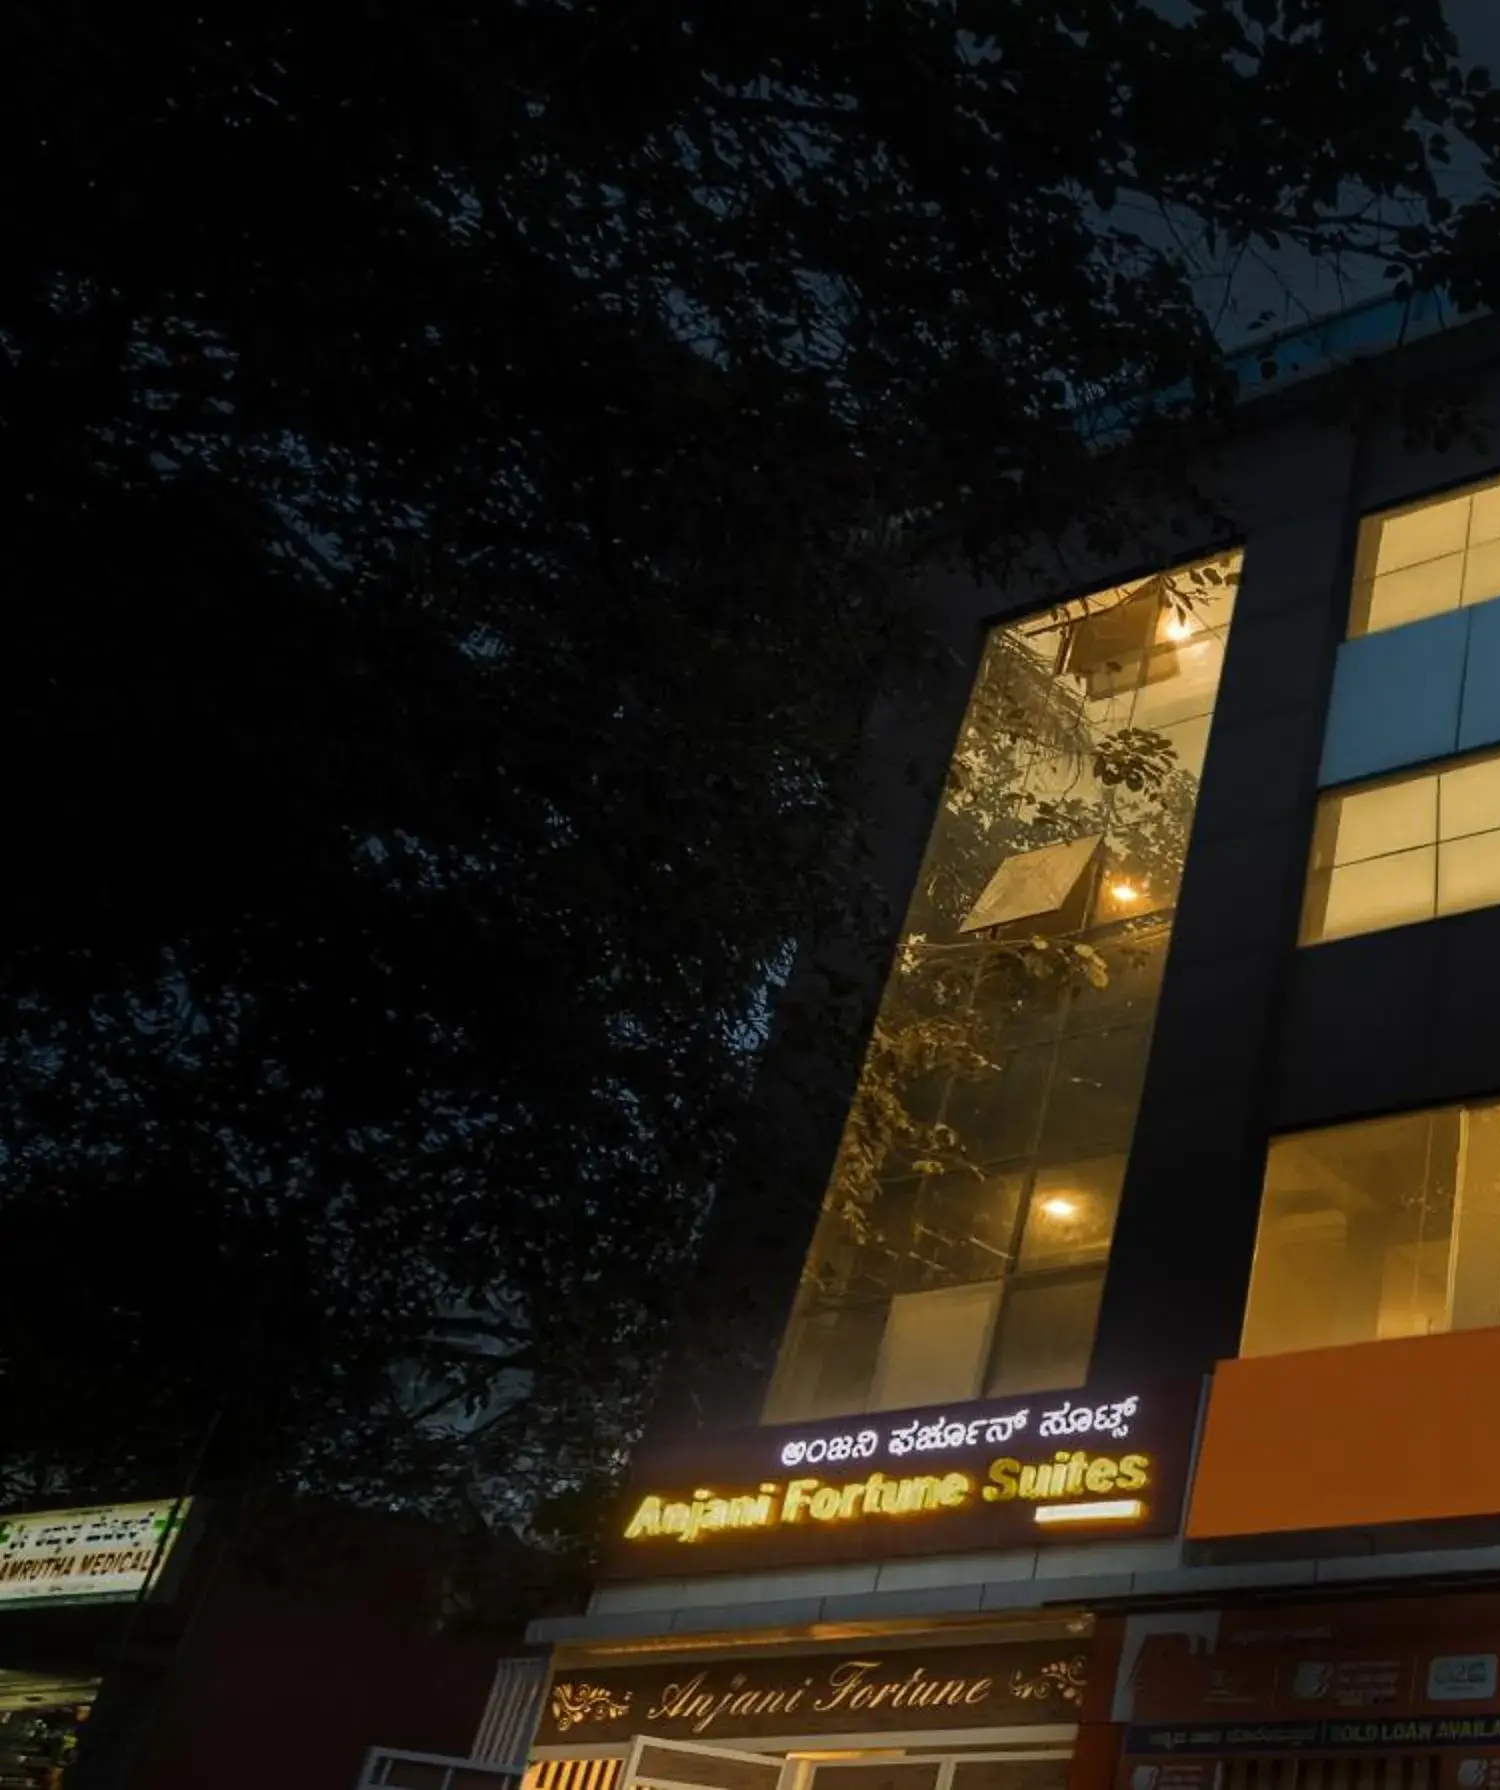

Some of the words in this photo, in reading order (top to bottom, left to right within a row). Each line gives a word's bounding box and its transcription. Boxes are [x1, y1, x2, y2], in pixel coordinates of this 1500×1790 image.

[782, 1429, 879, 1466] ಅಂಜನಿ
[624, 1484, 774, 1543] Anjani
[781, 1470, 971, 1522] Fortune
[982, 1450, 1149, 1501] Suites
[80, 1549, 159, 1576] MEDICAL
[648, 1672, 812, 1732] Anjani
[814, 1661, 993, 1711] Fortune
[1381, 1722, 1434, 1741] LOAN
